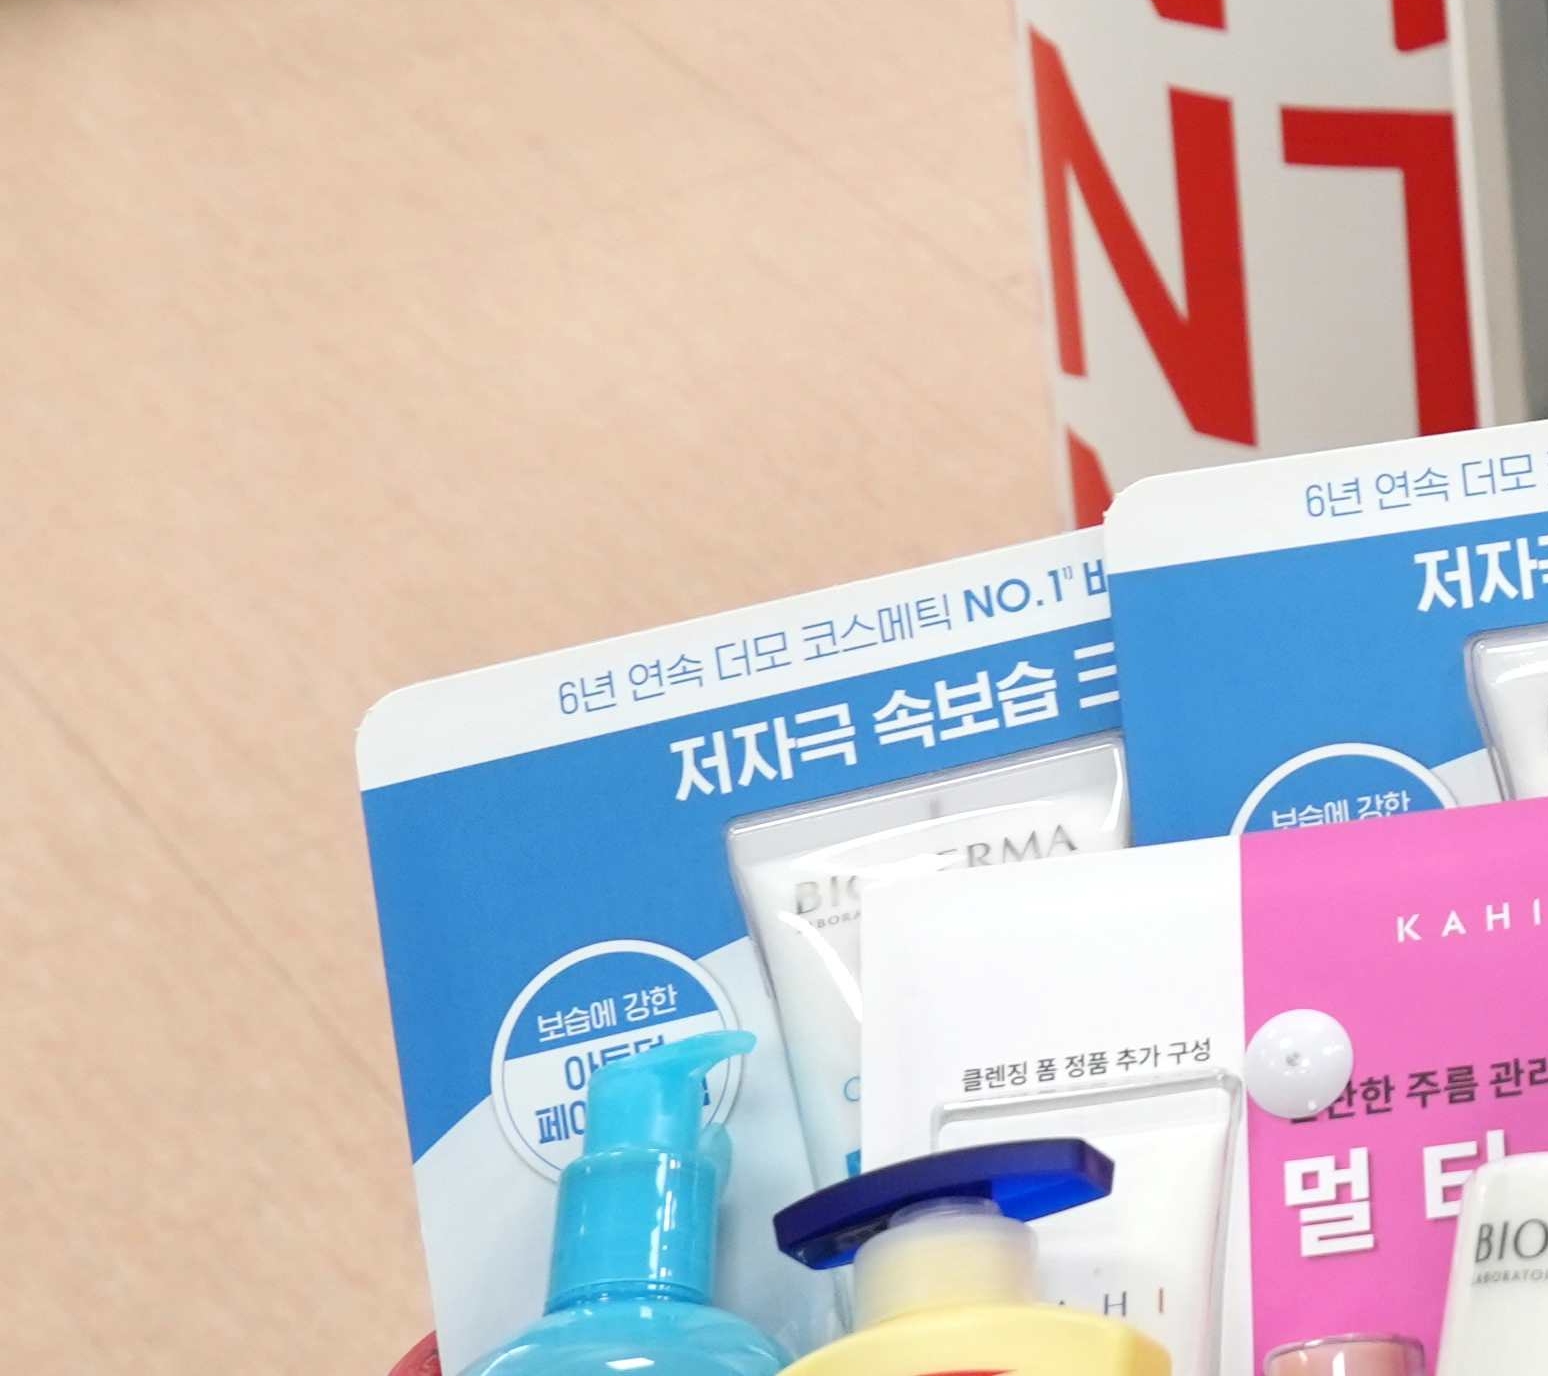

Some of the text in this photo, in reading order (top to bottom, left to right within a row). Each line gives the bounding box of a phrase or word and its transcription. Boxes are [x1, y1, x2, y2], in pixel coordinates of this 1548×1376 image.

[1304, 451, 1537, 520] 6년 연속 더모
[558, 593, 954, 717] 6년 연속 더모 코스메틱
[669, 660, 1060, 802] 저자극 속보습
[537, 983, 679, 1045] 보습에 강한
[1034, 1037, 1213, 1085] 폼 정품 추가 구성
[1406, 1064, 1478, 1109] 주름
